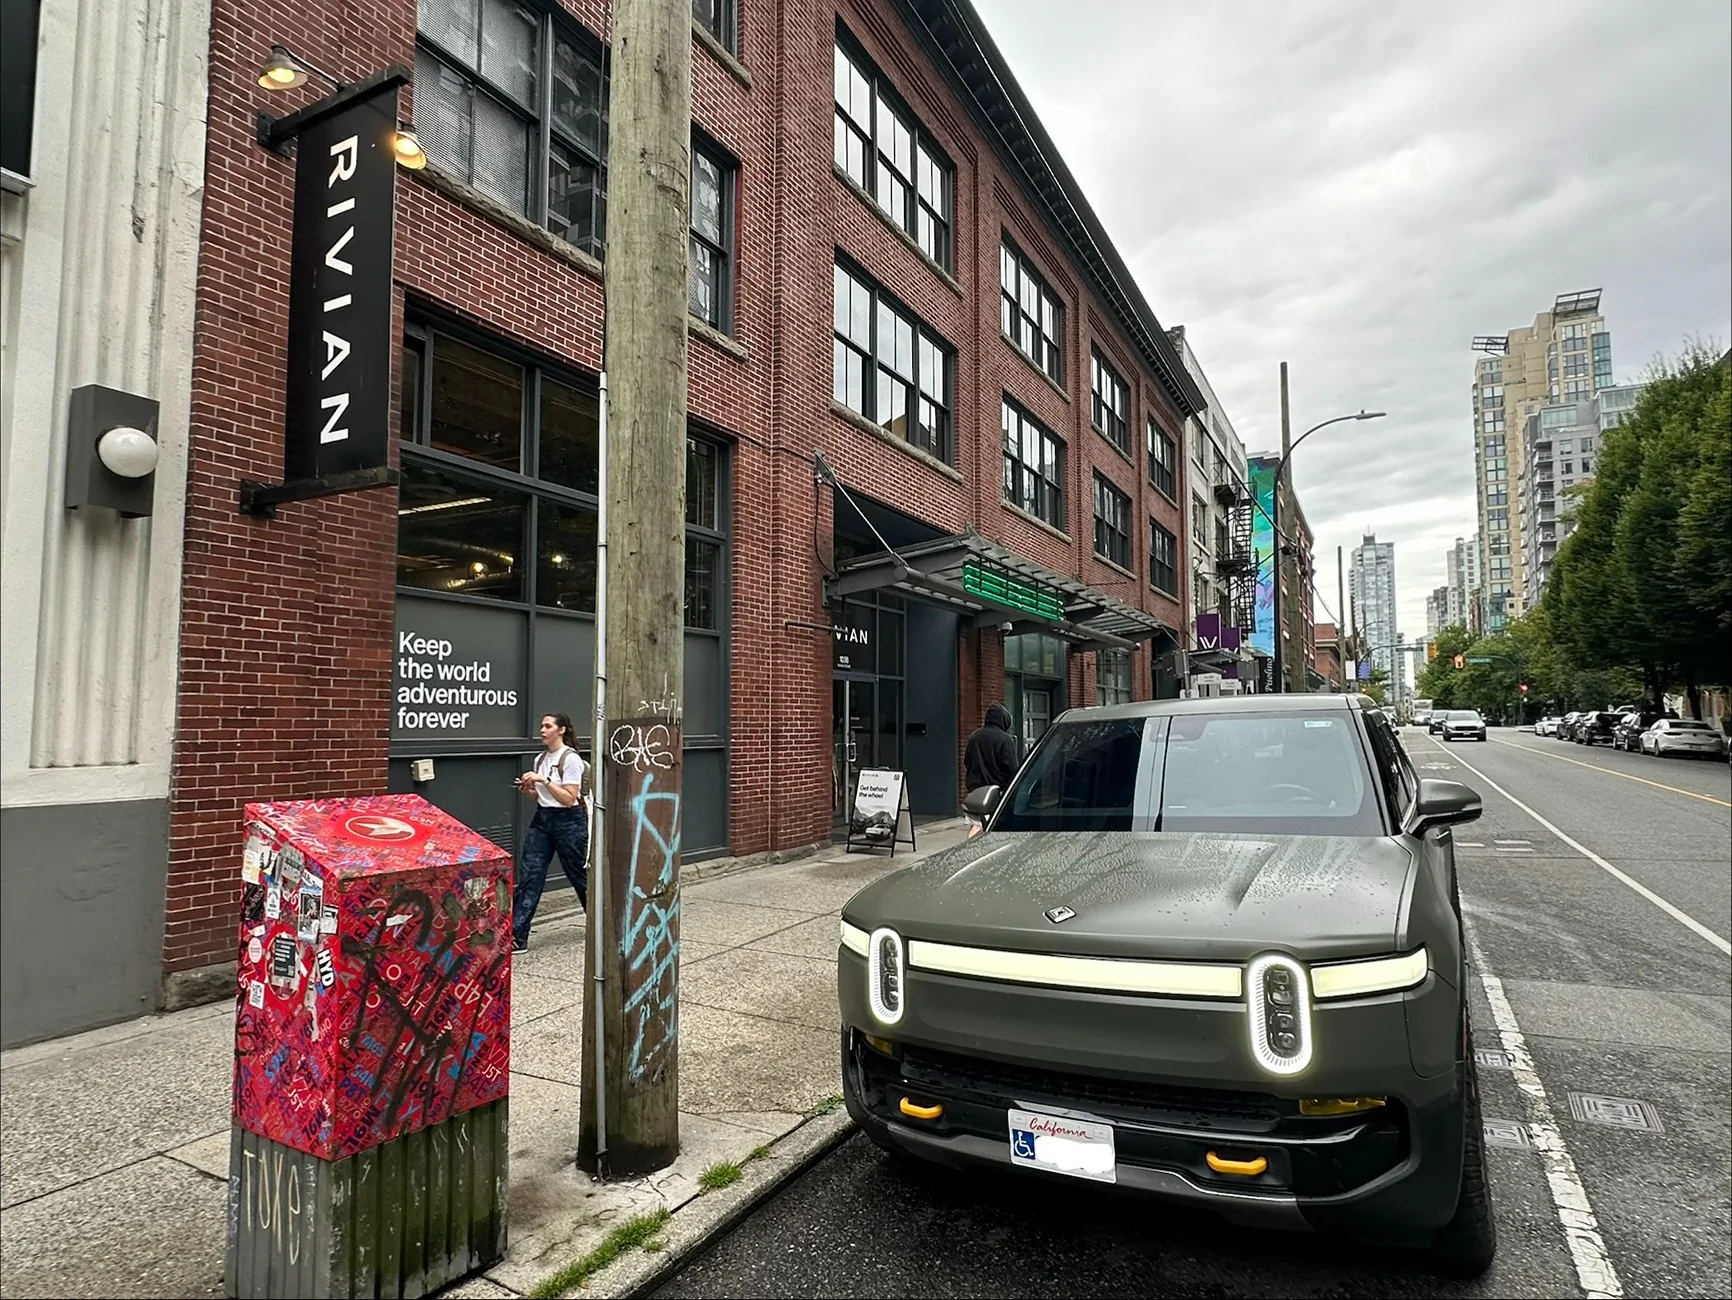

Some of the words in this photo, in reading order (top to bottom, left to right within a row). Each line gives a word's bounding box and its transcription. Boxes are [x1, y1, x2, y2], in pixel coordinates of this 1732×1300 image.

[319, 135, 358, 445] RIVIAN
[399, 631, 452, 661] Keep
[398, 657, 433, 680] the
[437, 661, 490, 682] world
[397, 682, 518, 706] adventurous
[397, 706, 469, 729] forever
[870, 785, 888, 793] behind
[317, 949, 335, 988] HYD
[402, 993, 424, 1016] JT
[482, 1062, 501, 1083] J5T
[1029, 1117, 1094, 1139] California
